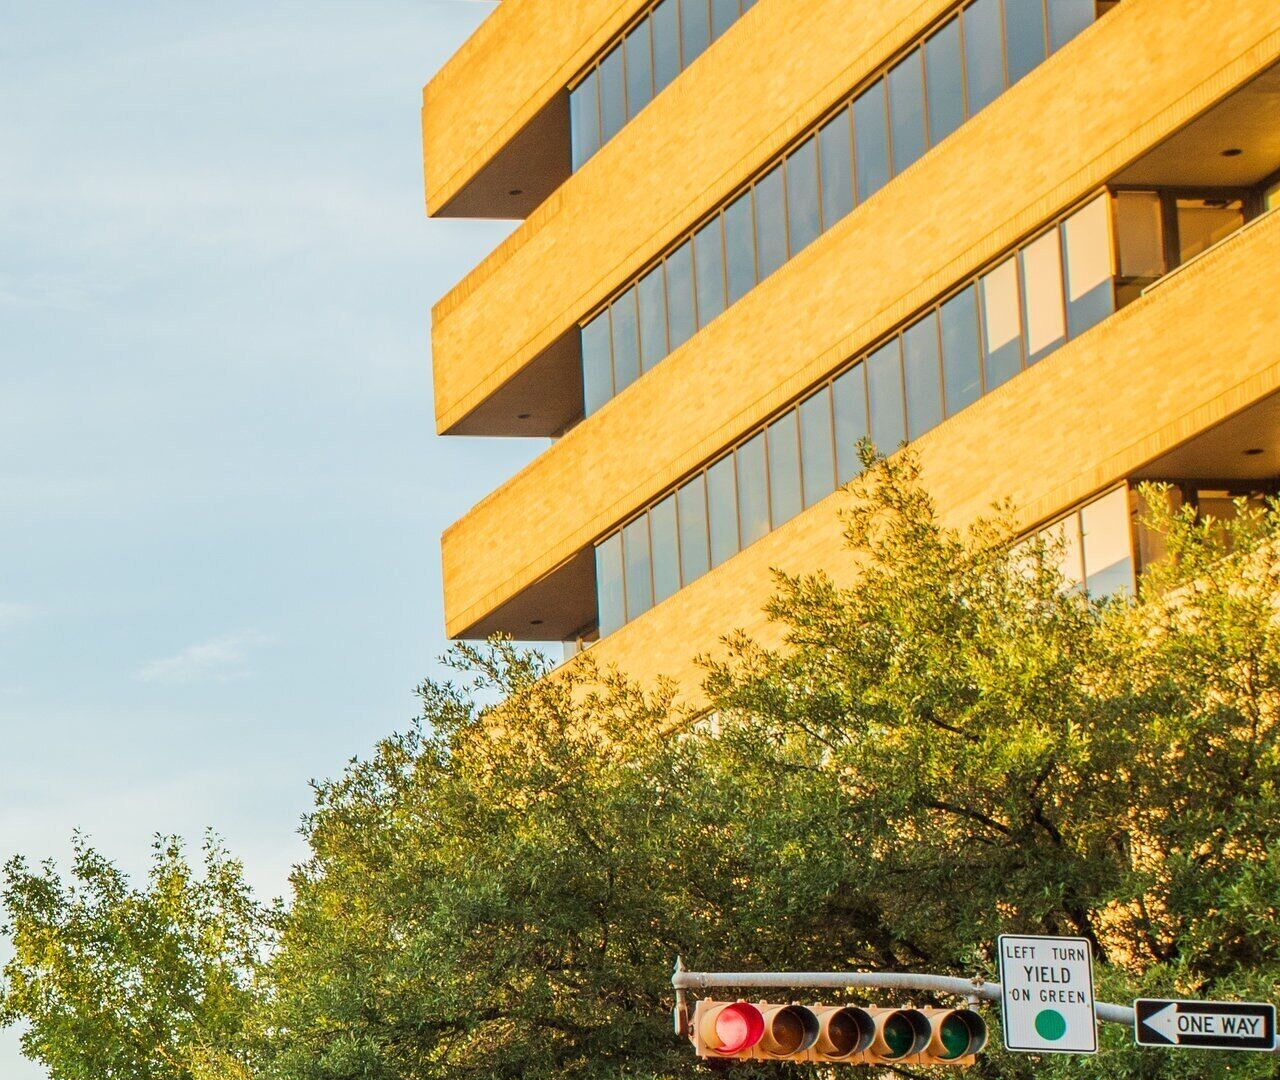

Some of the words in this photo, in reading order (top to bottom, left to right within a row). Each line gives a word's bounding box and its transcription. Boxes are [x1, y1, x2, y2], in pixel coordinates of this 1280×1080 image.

[1006, 945, 1036, 959] LEFT
[1051, 947, 1085, 961] TURN
[1023, 965, 1071, 984] YIELD
[1012, 988, 1031, 1002] ON
[1039, 989, 1086, 1004] GREEN
[1177, 1015, 1215, 1033] ONE
[1221, 1016, 1260, 1035] WAY
